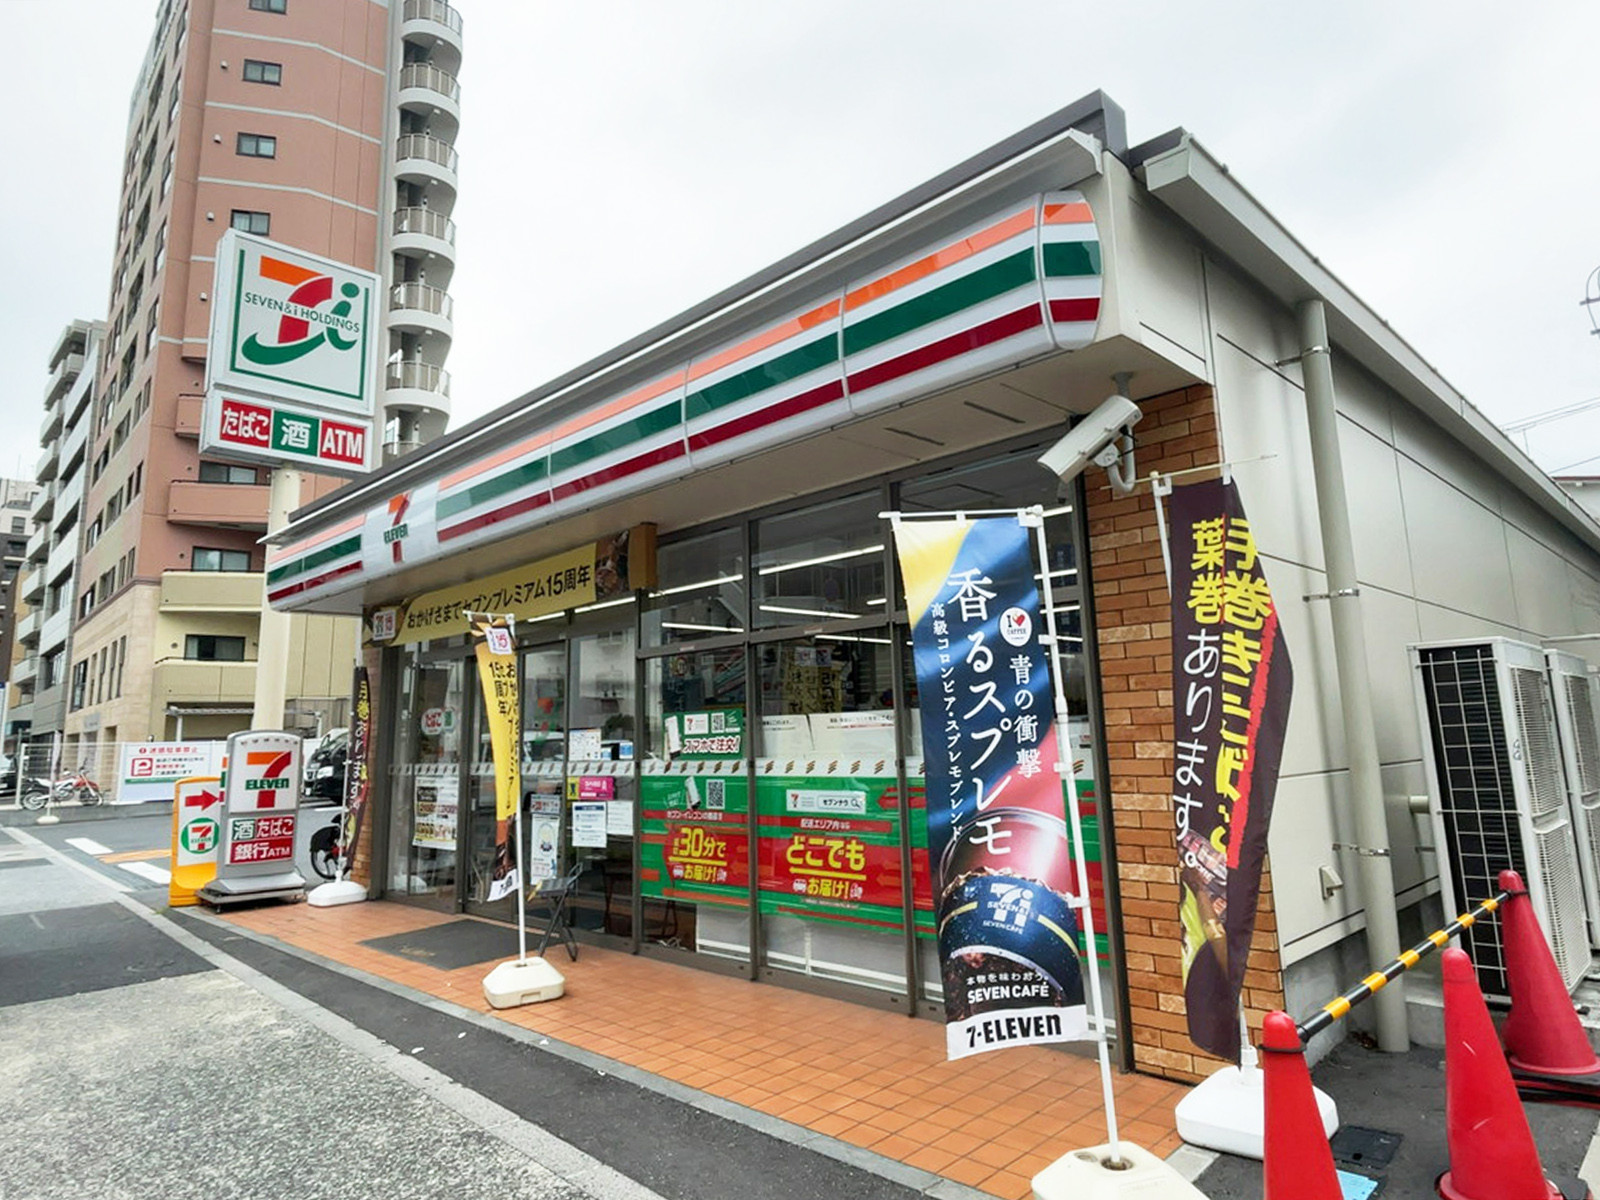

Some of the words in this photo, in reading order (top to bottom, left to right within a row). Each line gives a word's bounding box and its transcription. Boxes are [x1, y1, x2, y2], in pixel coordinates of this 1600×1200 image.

[300, 308, 360, 334] HOLDINGS
[223, 407, 269, 440] たばこ
[281, 418, 312, 449] 酒
[322, 427, 363, 459] ATM
[407, 564, 591, 629] おかげさまでセブンプレミアム15周年
[946, 567, 1013, 855] 香るスプレモ
[1009, 654, 1043, 779] 青の衝撃
[233, 820, 255, 840] 酒
[256, 818, 293, 838] たばこ
[786, 836, 866, 871] どこでも
[684, 864, 717, 883] お届け!
[807, 877, 849, 899] お届け!
[967, 985, 1010, 1004] SEVEN
[1012, 981, 1050, 998] CAFÉ
